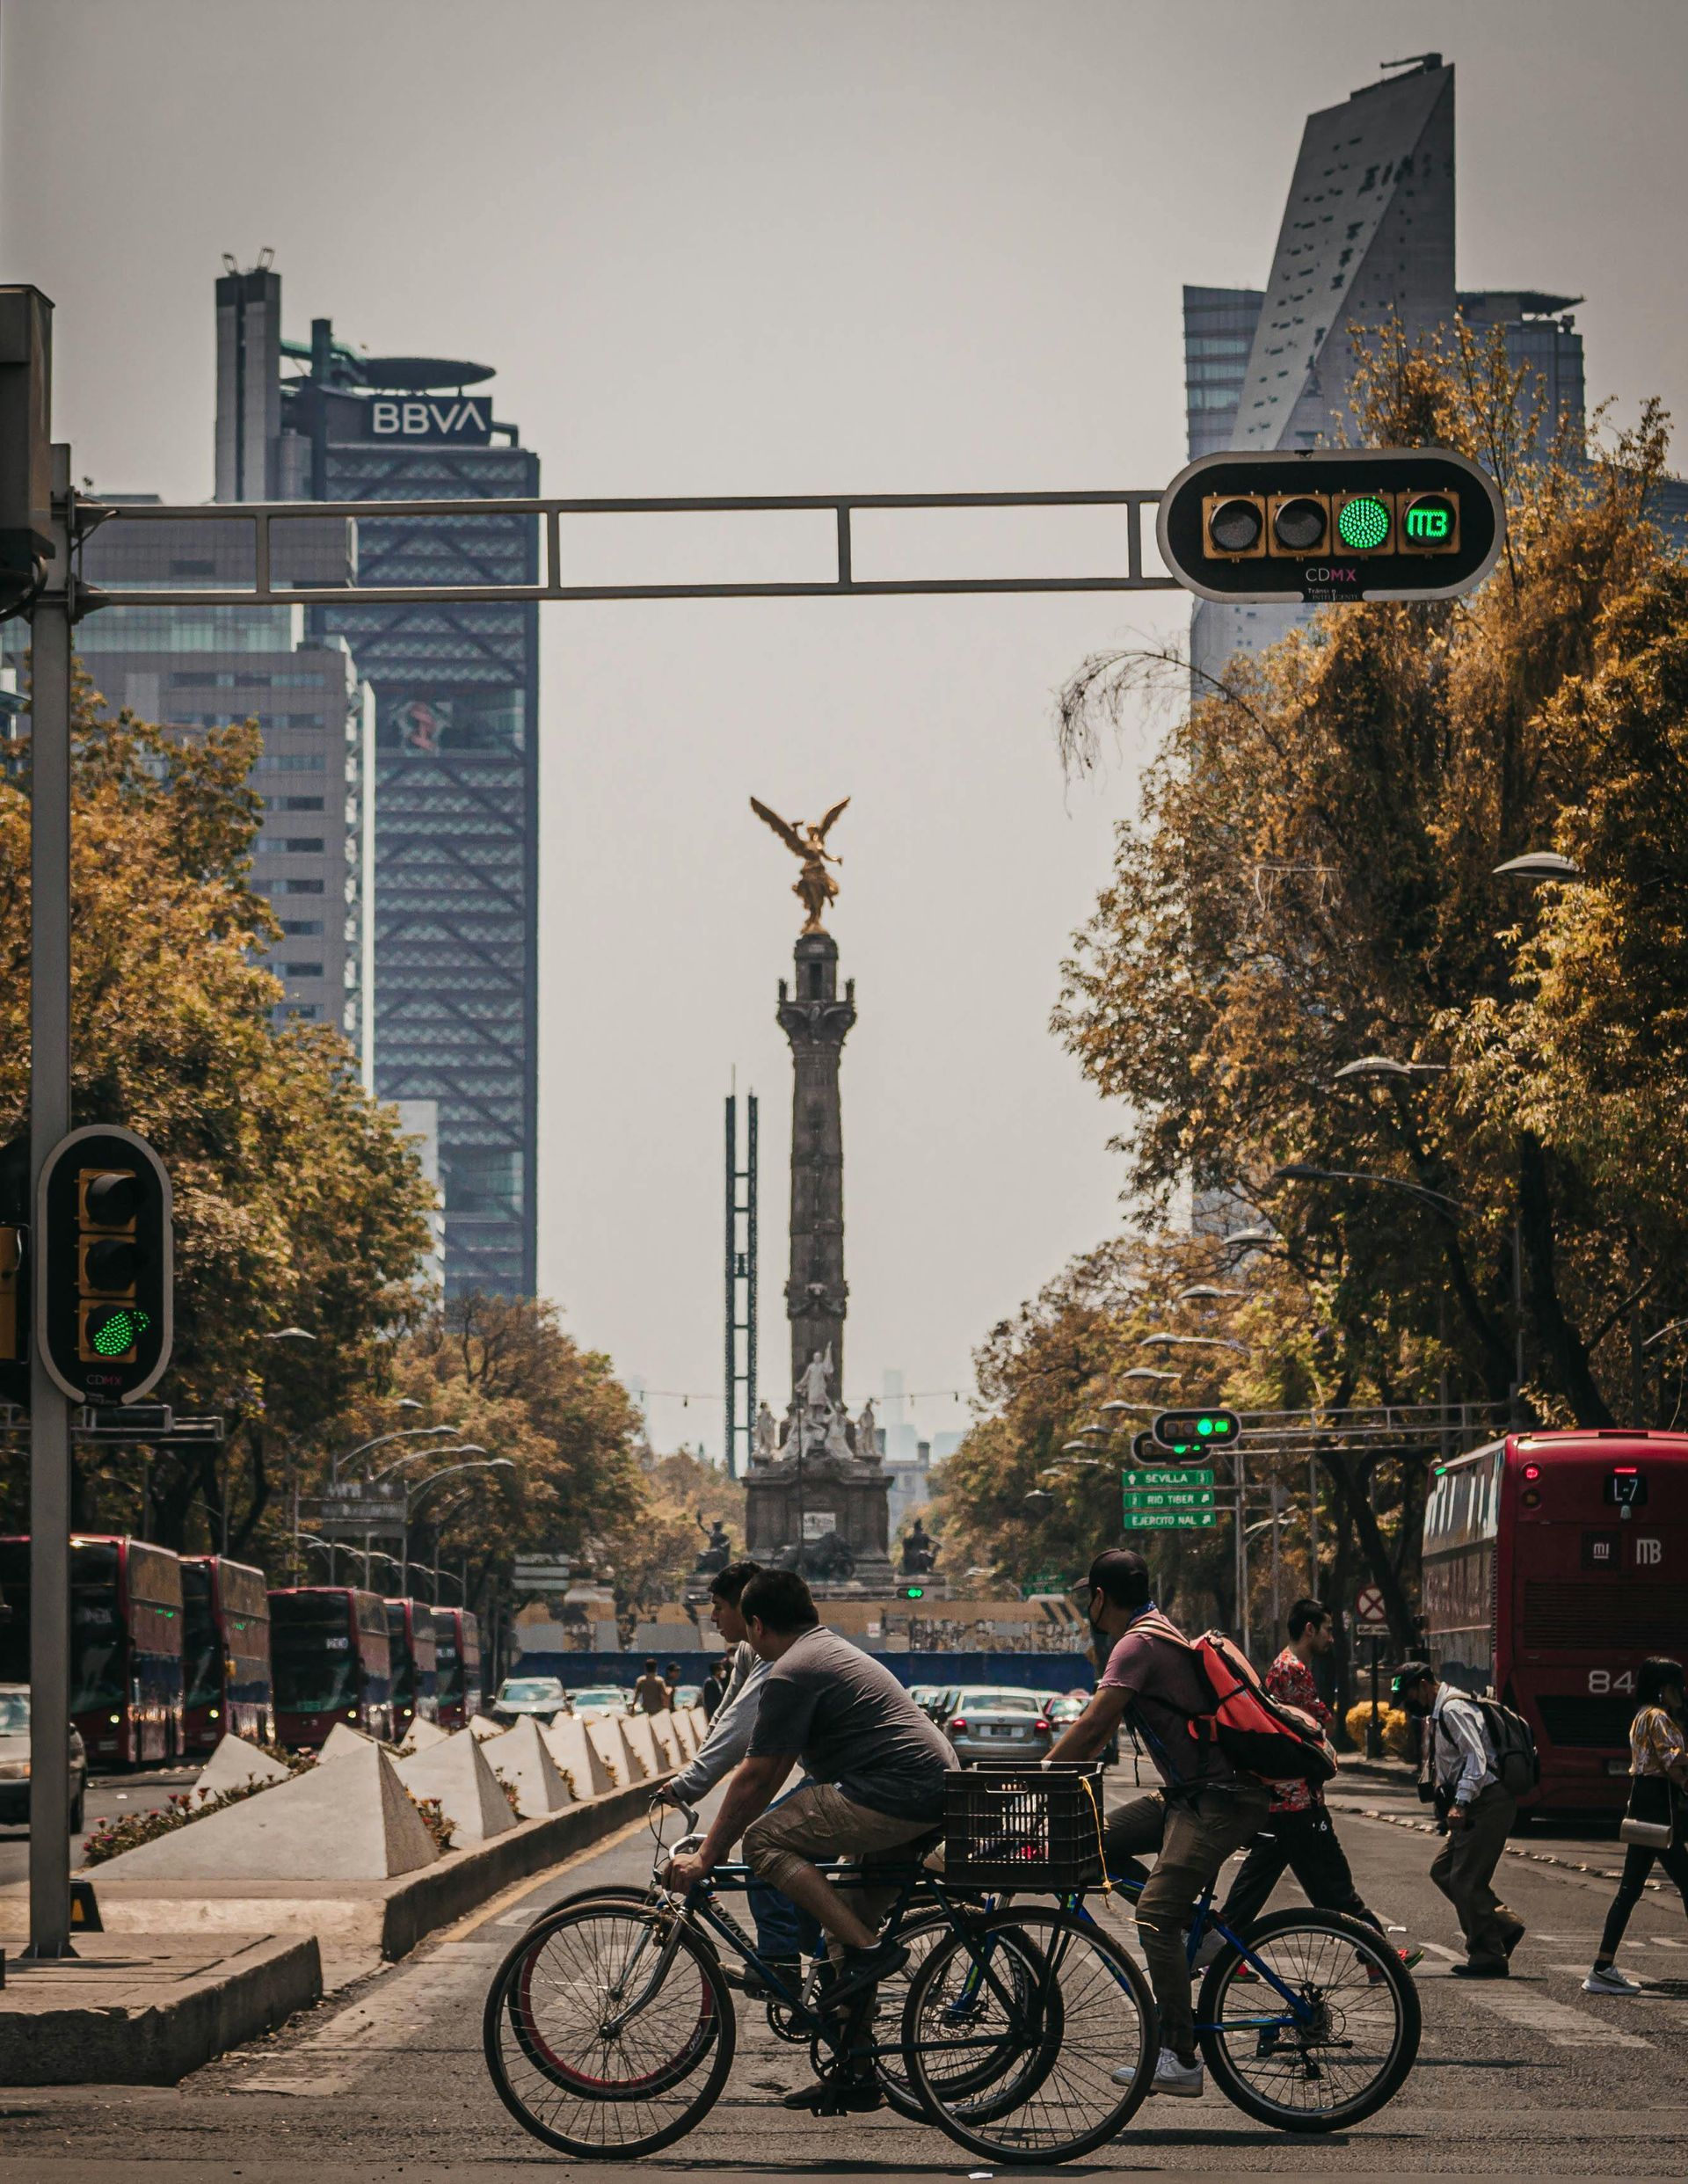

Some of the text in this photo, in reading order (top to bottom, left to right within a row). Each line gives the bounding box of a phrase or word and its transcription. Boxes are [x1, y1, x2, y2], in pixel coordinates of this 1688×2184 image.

[373, 401, 486, 434] BBVA
[1306, 568, 1357, 582] CDMX
[1145, 1474, 1189, 1484] SEVILLA
[1613, 1478, 1638, 1502] L-7
[1168, 1495, 1194, 1505] TIBER
[1131, 1515, 1197, 1526] EJERCITO NAL
[1588, 1670, 1635, 1694] 84
